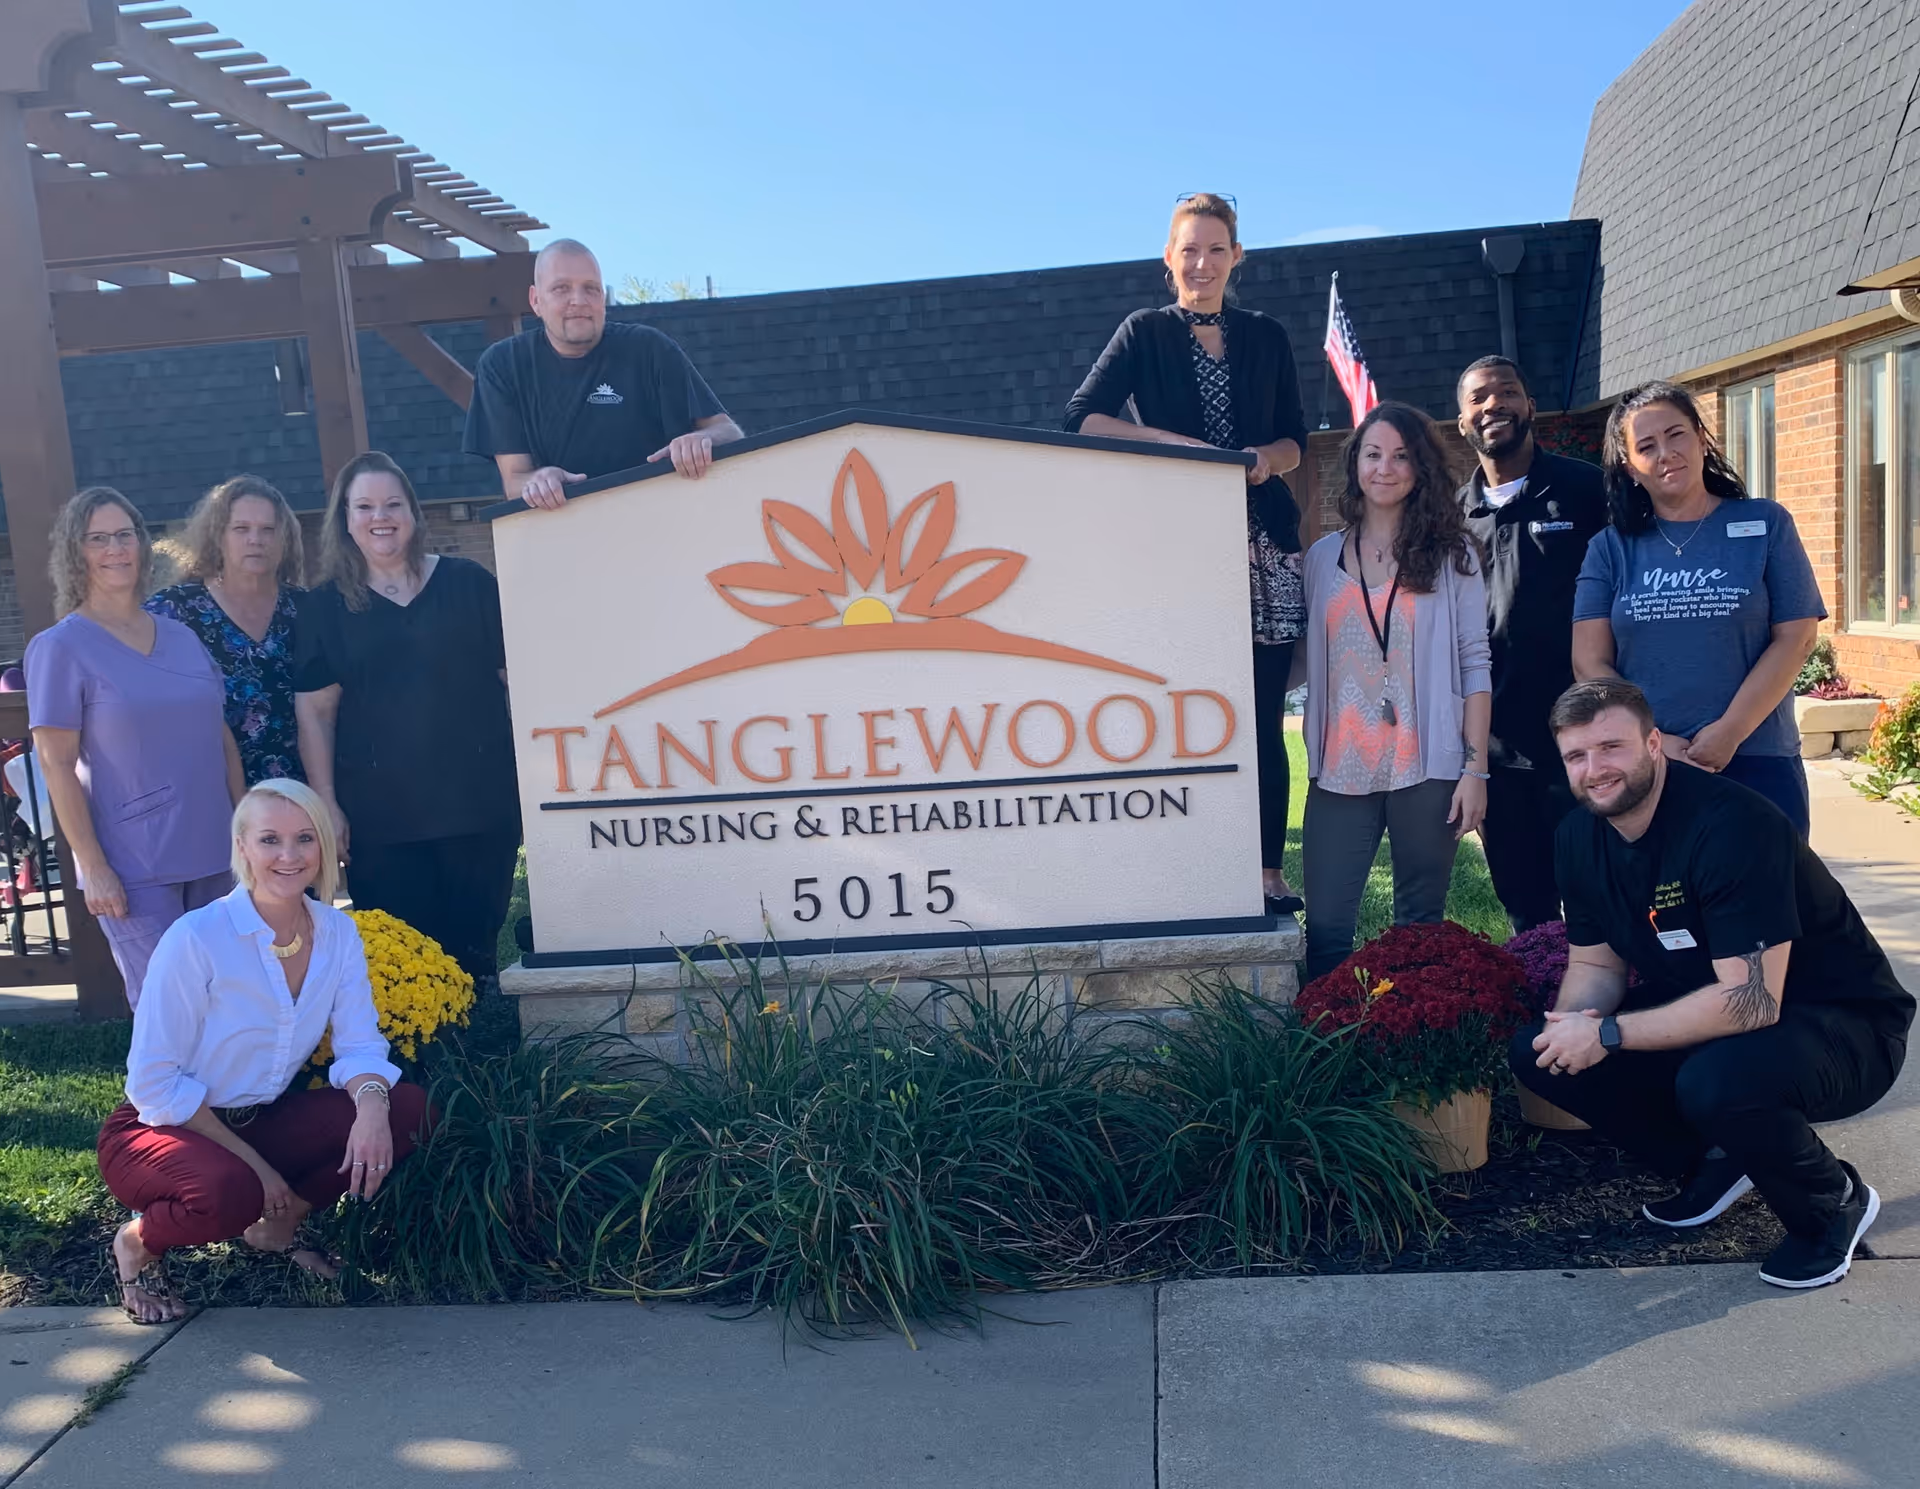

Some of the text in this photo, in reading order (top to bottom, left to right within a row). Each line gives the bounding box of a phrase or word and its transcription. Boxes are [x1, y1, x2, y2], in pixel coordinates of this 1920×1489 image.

[1631, 592, 1739, 607] life saving rockstar who lives
[1638, 590, 1659, 599] scrub
[1695, 585, 1715, 594] smile
[1634, 605, 1650, 614] heal
[1652, 602, 1667, 612] and
[1669, 602, 1688, 611] loves
[1663, 610, 1680, 619] kind
[1682, 609, 1690, 618] of
[1698, 608, 1711, 619] big
[532, 688, 1237, 793] TANGLEWOOD
[589, 786, 1190, 850] NURSING & REHABILITATION
[793, 869, 957, 923] 5015
